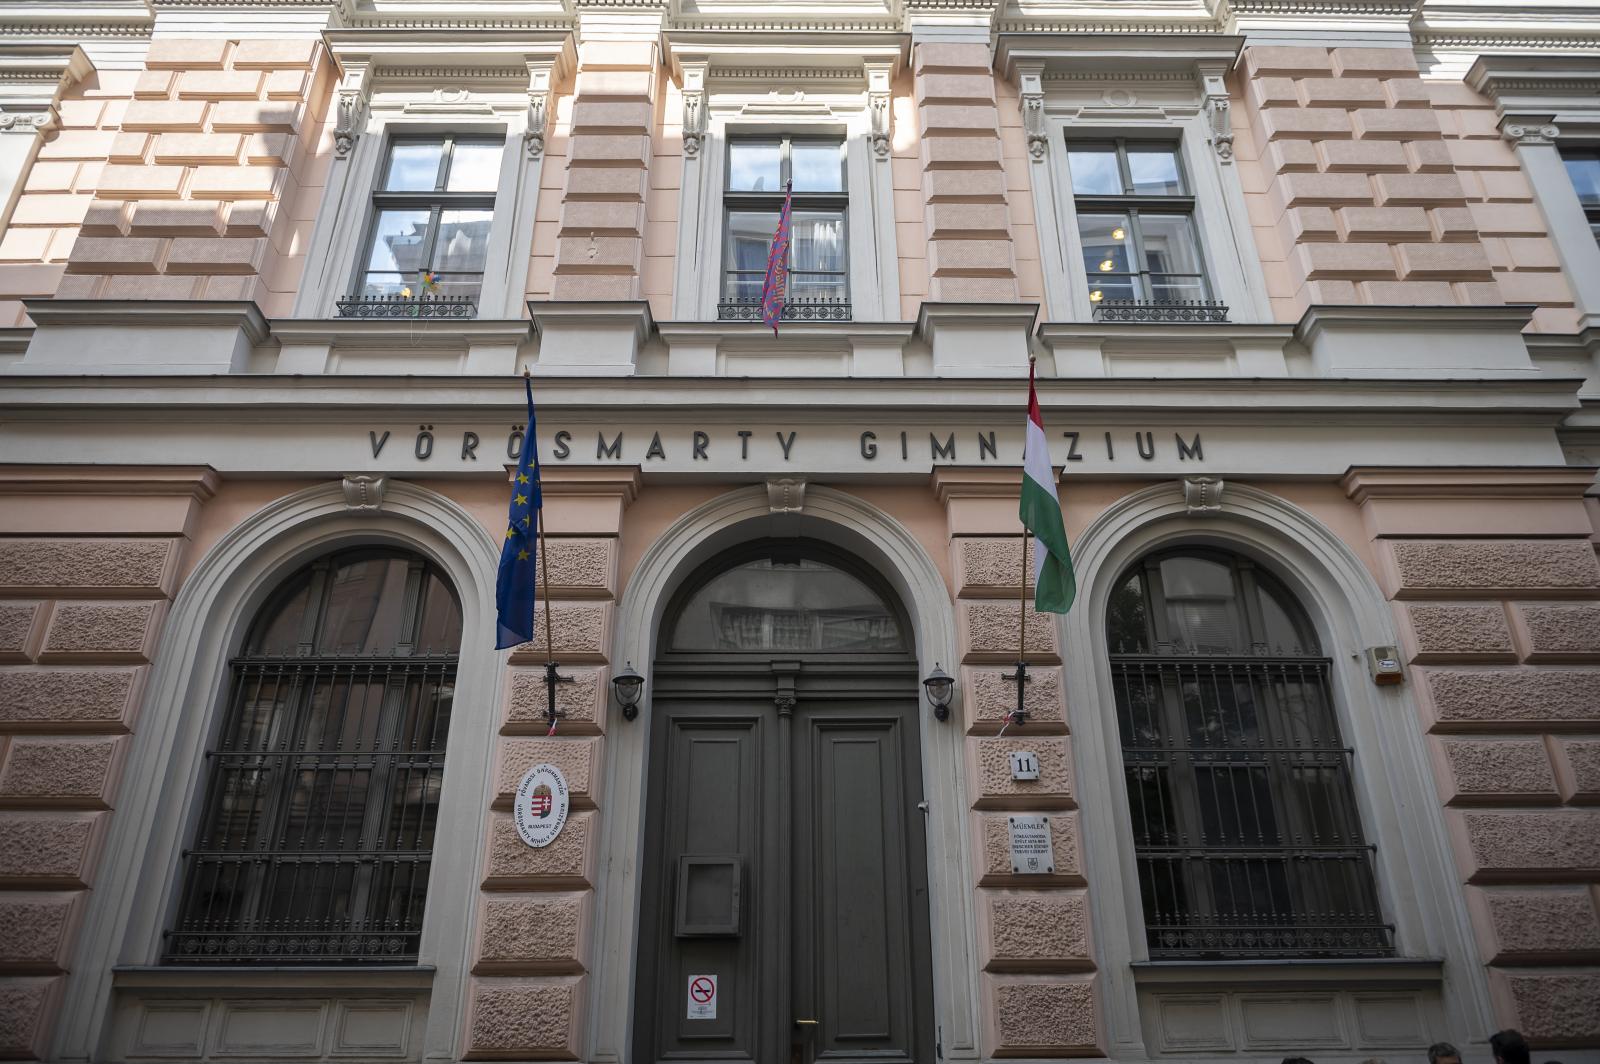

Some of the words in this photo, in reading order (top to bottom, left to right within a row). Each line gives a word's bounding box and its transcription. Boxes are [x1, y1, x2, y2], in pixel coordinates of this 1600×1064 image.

[369, 425, 797, 460] VÖRÖSMARTY
[860, 431, 1204, 460] GIMNZIUM
[1017, 758, 1036, 772] 11.
